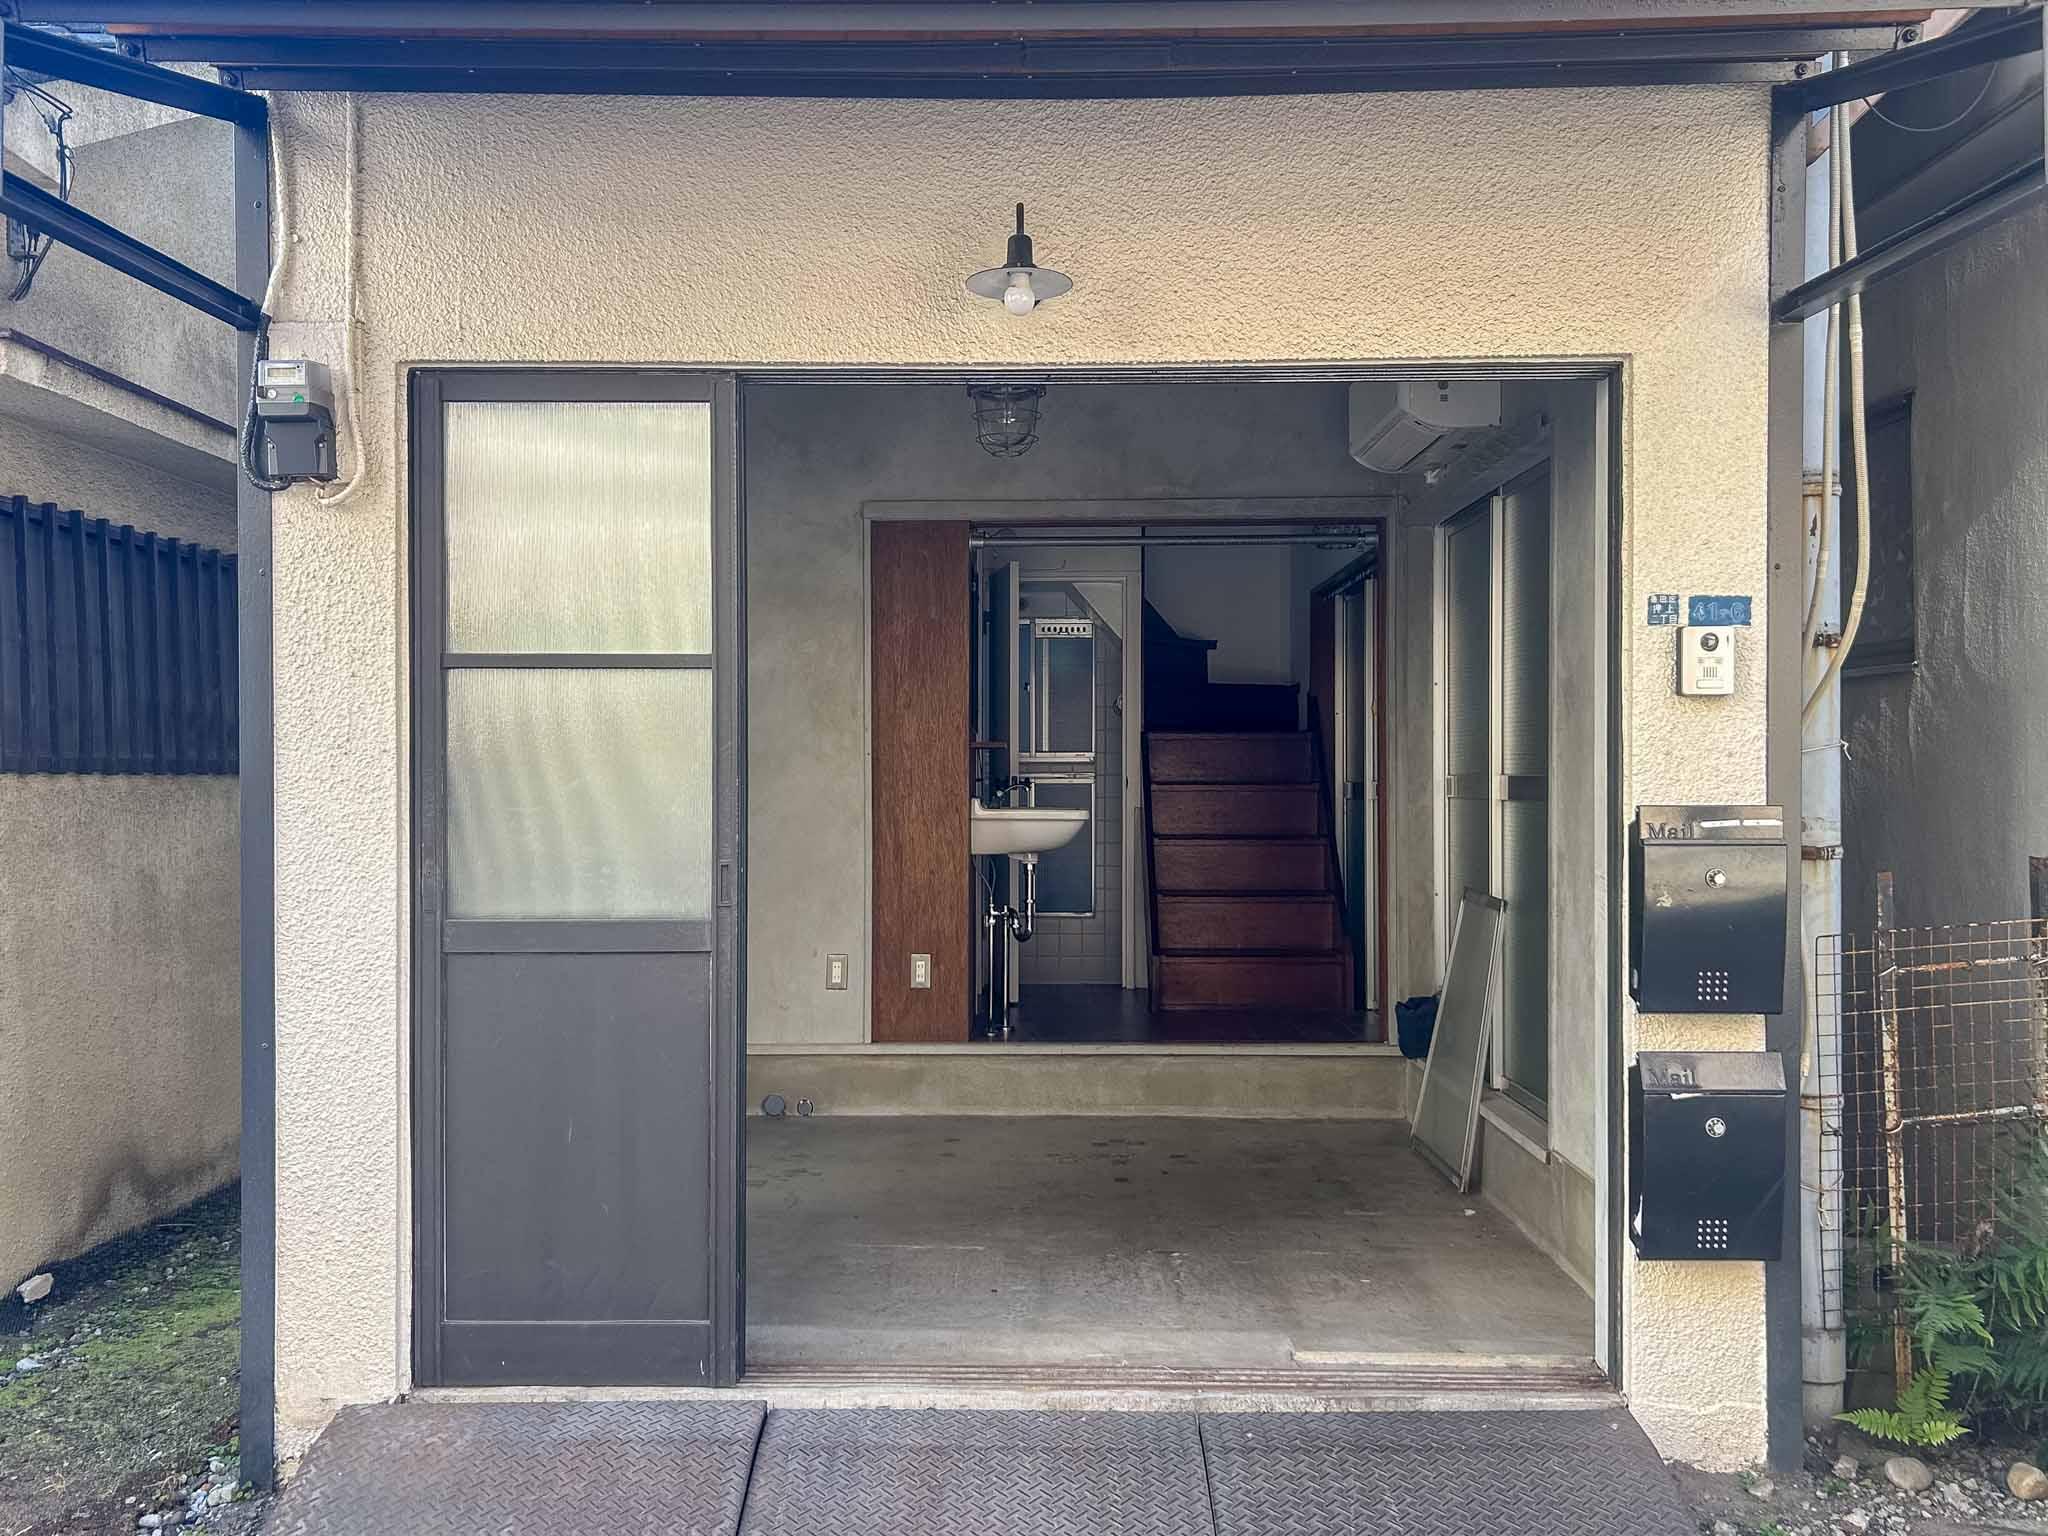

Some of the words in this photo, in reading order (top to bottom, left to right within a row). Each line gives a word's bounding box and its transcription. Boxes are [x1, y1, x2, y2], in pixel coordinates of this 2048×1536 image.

[1649, 614, 1677, 624] 二丁目
[1646, 822, 1695, 840] Mail
[1648, 1068, 1695, 1087] Mail
